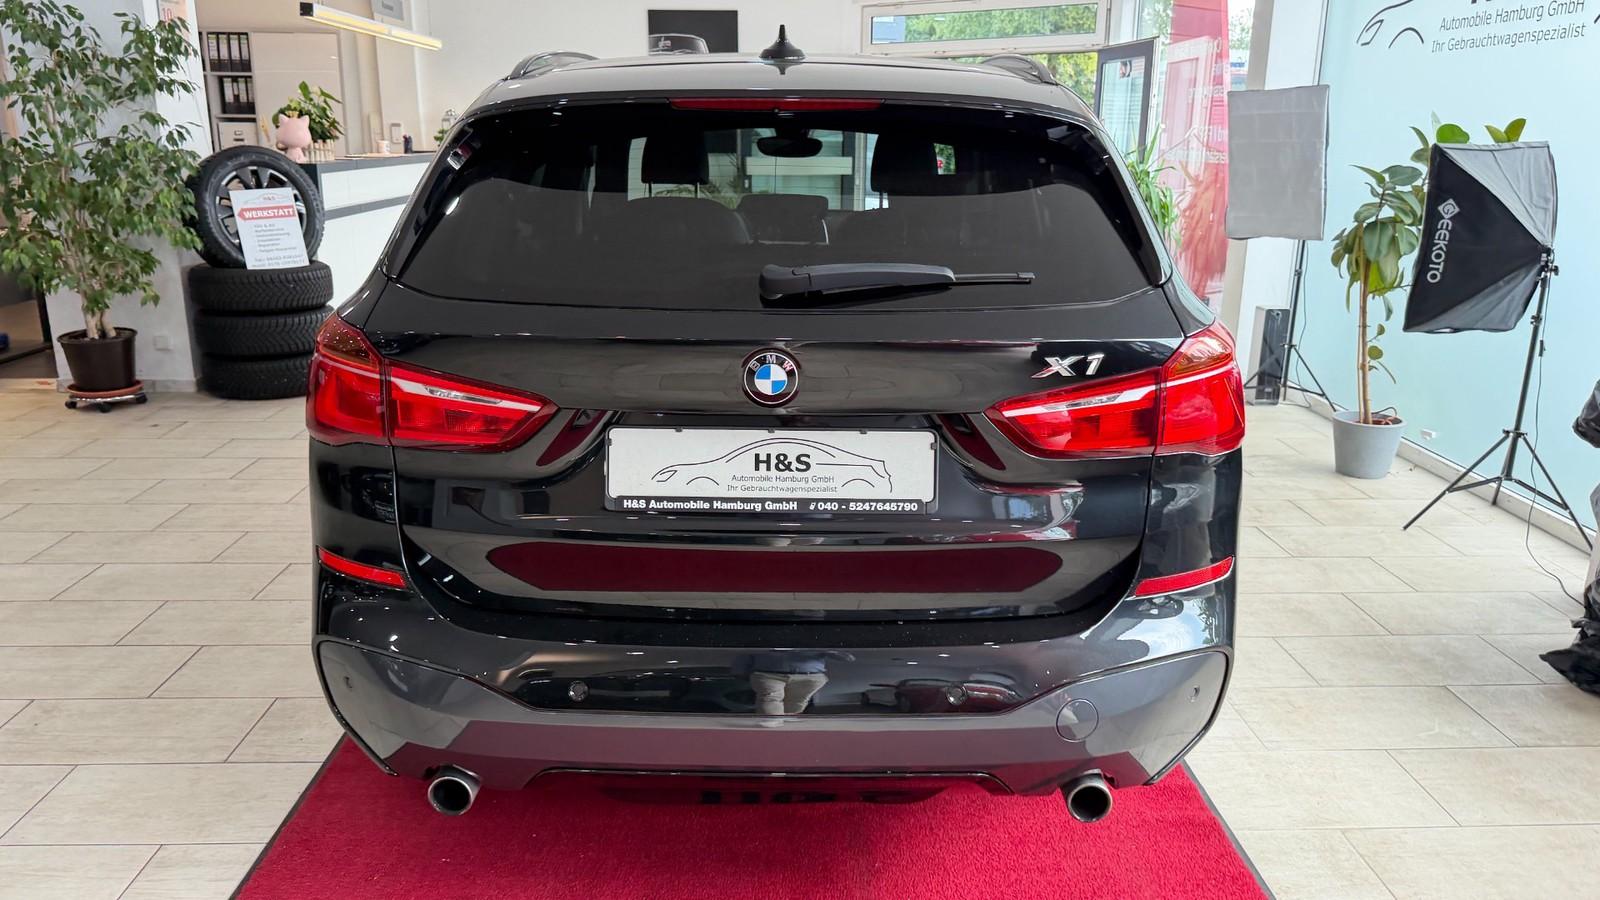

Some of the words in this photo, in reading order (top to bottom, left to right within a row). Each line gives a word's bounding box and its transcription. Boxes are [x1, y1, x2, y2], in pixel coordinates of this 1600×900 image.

[1439, 10, 1492, 32] Automobile
[1494, 4, 1544, 23] Hamburg
[1547, 0, 1585, 17] GmbH
[1431, 40, 1446, 53] Ihr
[1447, 22, 1586, 52] Gebrauchtwagenspezialist
[243, 208, 294, 219] WERKSTATT
[750, 354, 794, 371] BMW
[1031, 354, 1105, 379] X1
[754, 452, 811, 473] H&S
[731, 474, 773, 483] Automobile
[775, 474, 810, 485] Hamburg
[811, 474, 835, 484] GmbH
[727, 484, 739, 493] Ihr
[740, 483, 838, 494] Gebrauchtwagenspezialist
[623, 499, 647, 510] H&S
[649, 499, 710, 510] Automobile
[713, 499, 762, 513] Hamburg
[764, 500, 798, 511] GmbH
[817, 501, 839, 512] 040
[848, 501, 919, 512] 5247645790
